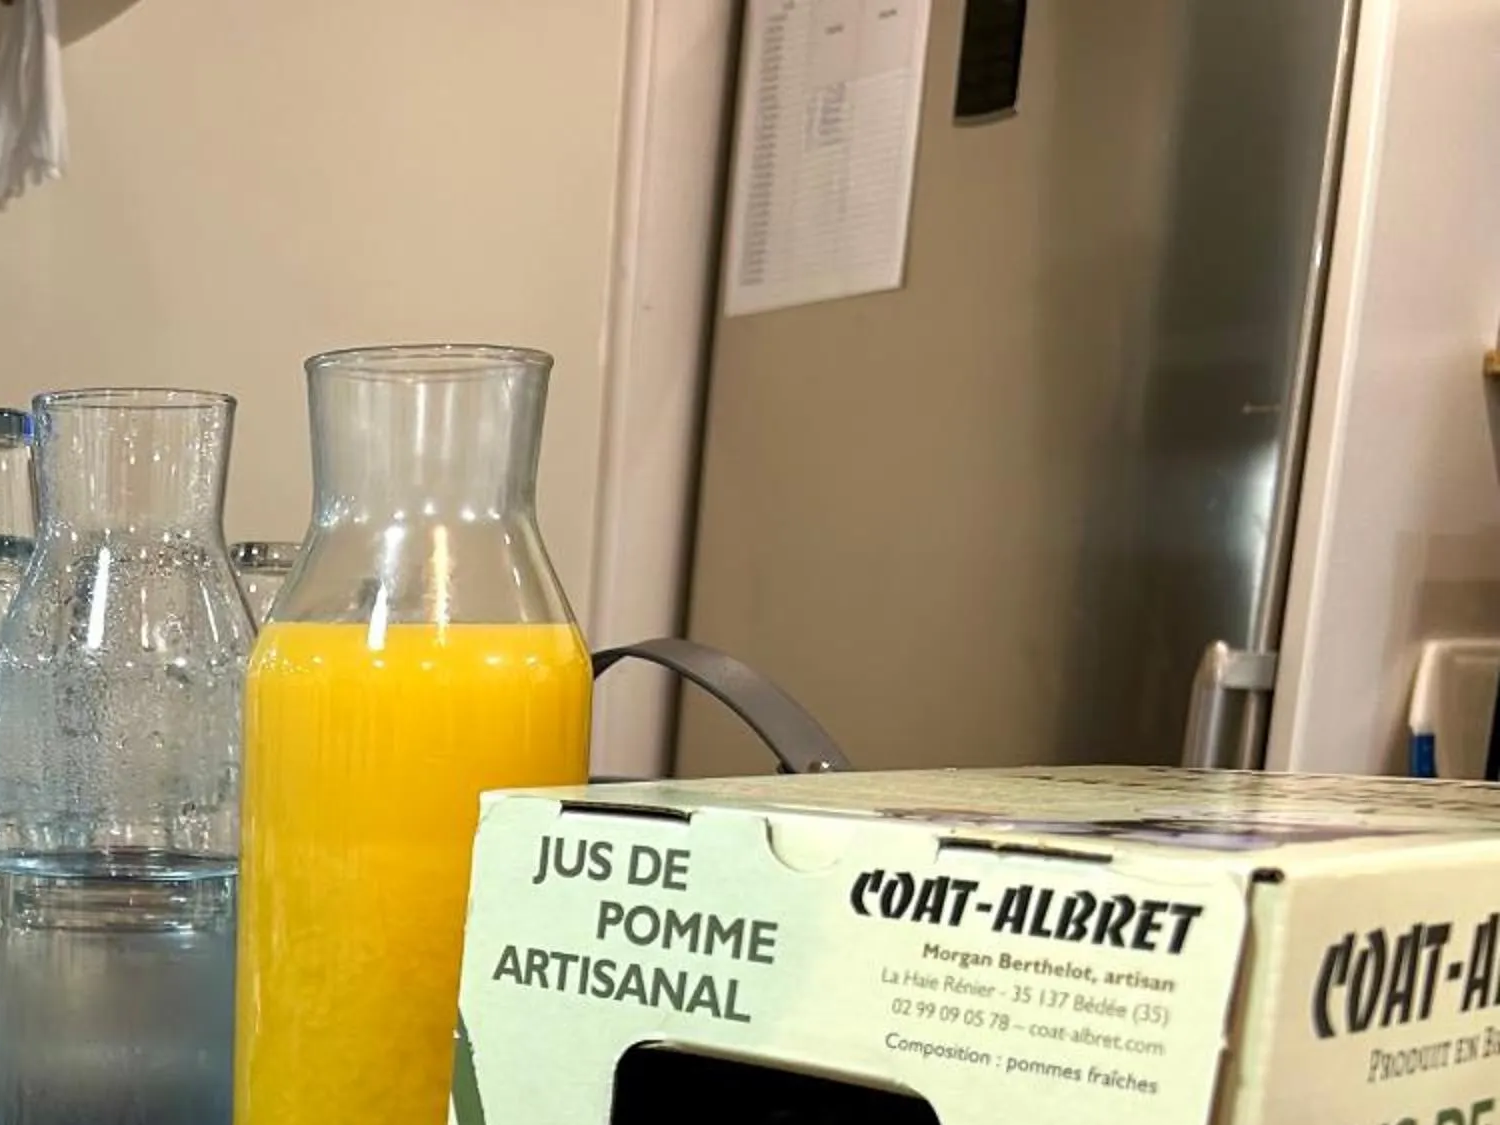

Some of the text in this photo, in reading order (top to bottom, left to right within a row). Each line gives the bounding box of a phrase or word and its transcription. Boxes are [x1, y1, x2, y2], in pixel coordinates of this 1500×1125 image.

[532, 836, 692, 891] JUS DE
[595, 900, 779, 964] POMME
[848, 869, 1205, 956] COAT-ALBRET
[492, 944, 752, 1023] ARTISANAL
[881, 966, 899, 985] La
[903, 969, 939, 991] Haie
[943, 975, 996, 998] Rénier
[1011, 984, 1033, 1004] 35
[1039, 988, 1070, 1009] 137
[1072, 993, 1127, 1018] Bédée
[1132, 1002, 1170, 1030] (35)
[921, 943, 1176, 993] Morgan Berthelot, artisan
[1311, 911, 1500, 1040] COAT-A
[891, 997, 912, 1017] 02
[915, 1001, 936, 1019] 99
[939, 1005, 961, 1023] 09
[964, 1009, 985, 1028] 05
[988, 1012, 1011, 1032] 78
[1028, 1022, 1166, 1056] coat-albret.com
[885, 1032, 991, 1067] Composition
[1006, 1055, 1082, 1082] pommes
[1087, 1064, 1159, 1095] fraîches
[1367, 1040, 1452, 1084] PRODUIT
[1454, 1034, 1480, 1065] EN
